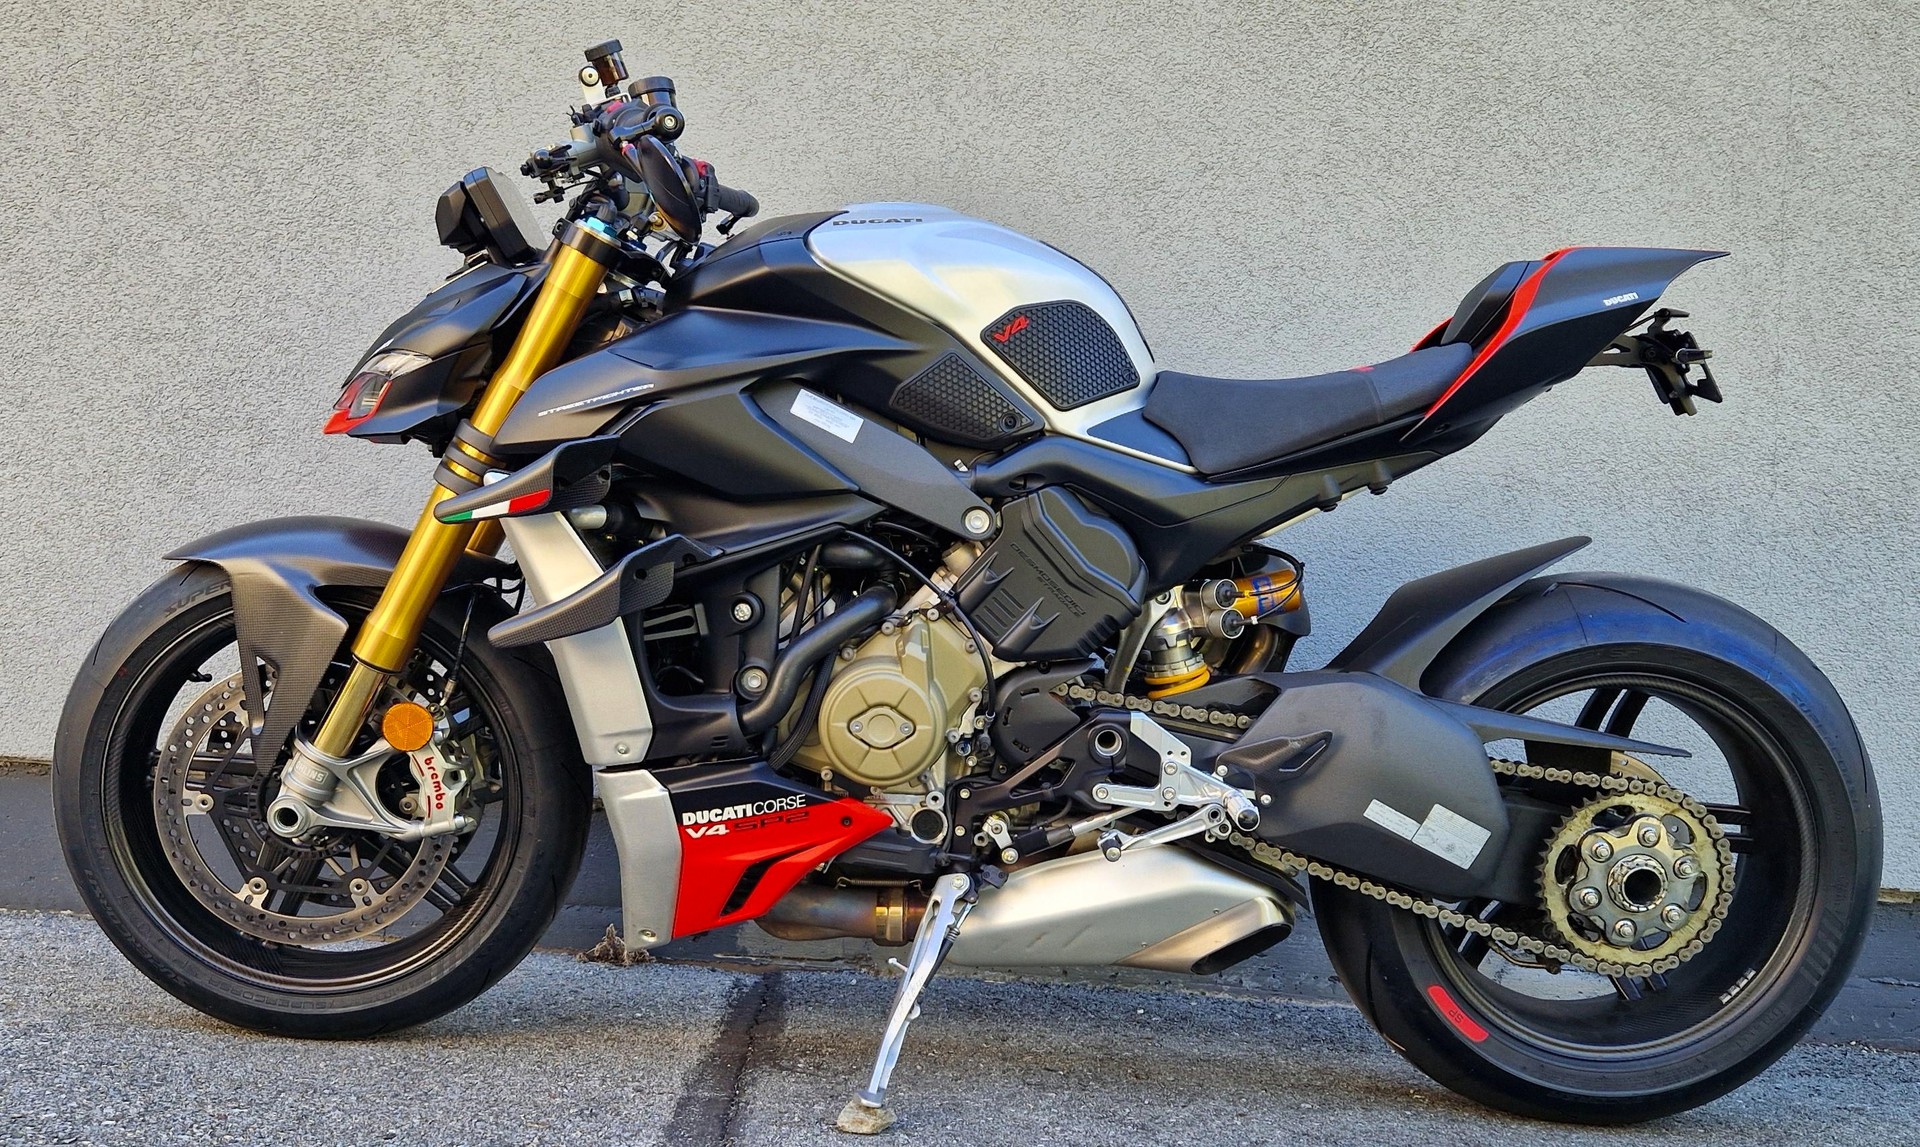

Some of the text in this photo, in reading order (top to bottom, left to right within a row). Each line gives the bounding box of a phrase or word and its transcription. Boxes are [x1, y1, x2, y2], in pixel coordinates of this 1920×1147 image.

[832, 217, 923, 227] DUCATI
[1603, 292, 1639, 307] DUCATI
[993, 315, 1030, 342] V4
[1010, 542, 1086, 616] DESMOSEDICI
[424, 756, 446, 811] brembo
[685, 811, 810, 839] V4 SP2
[1448, 1009, 1464, 1024] SP
